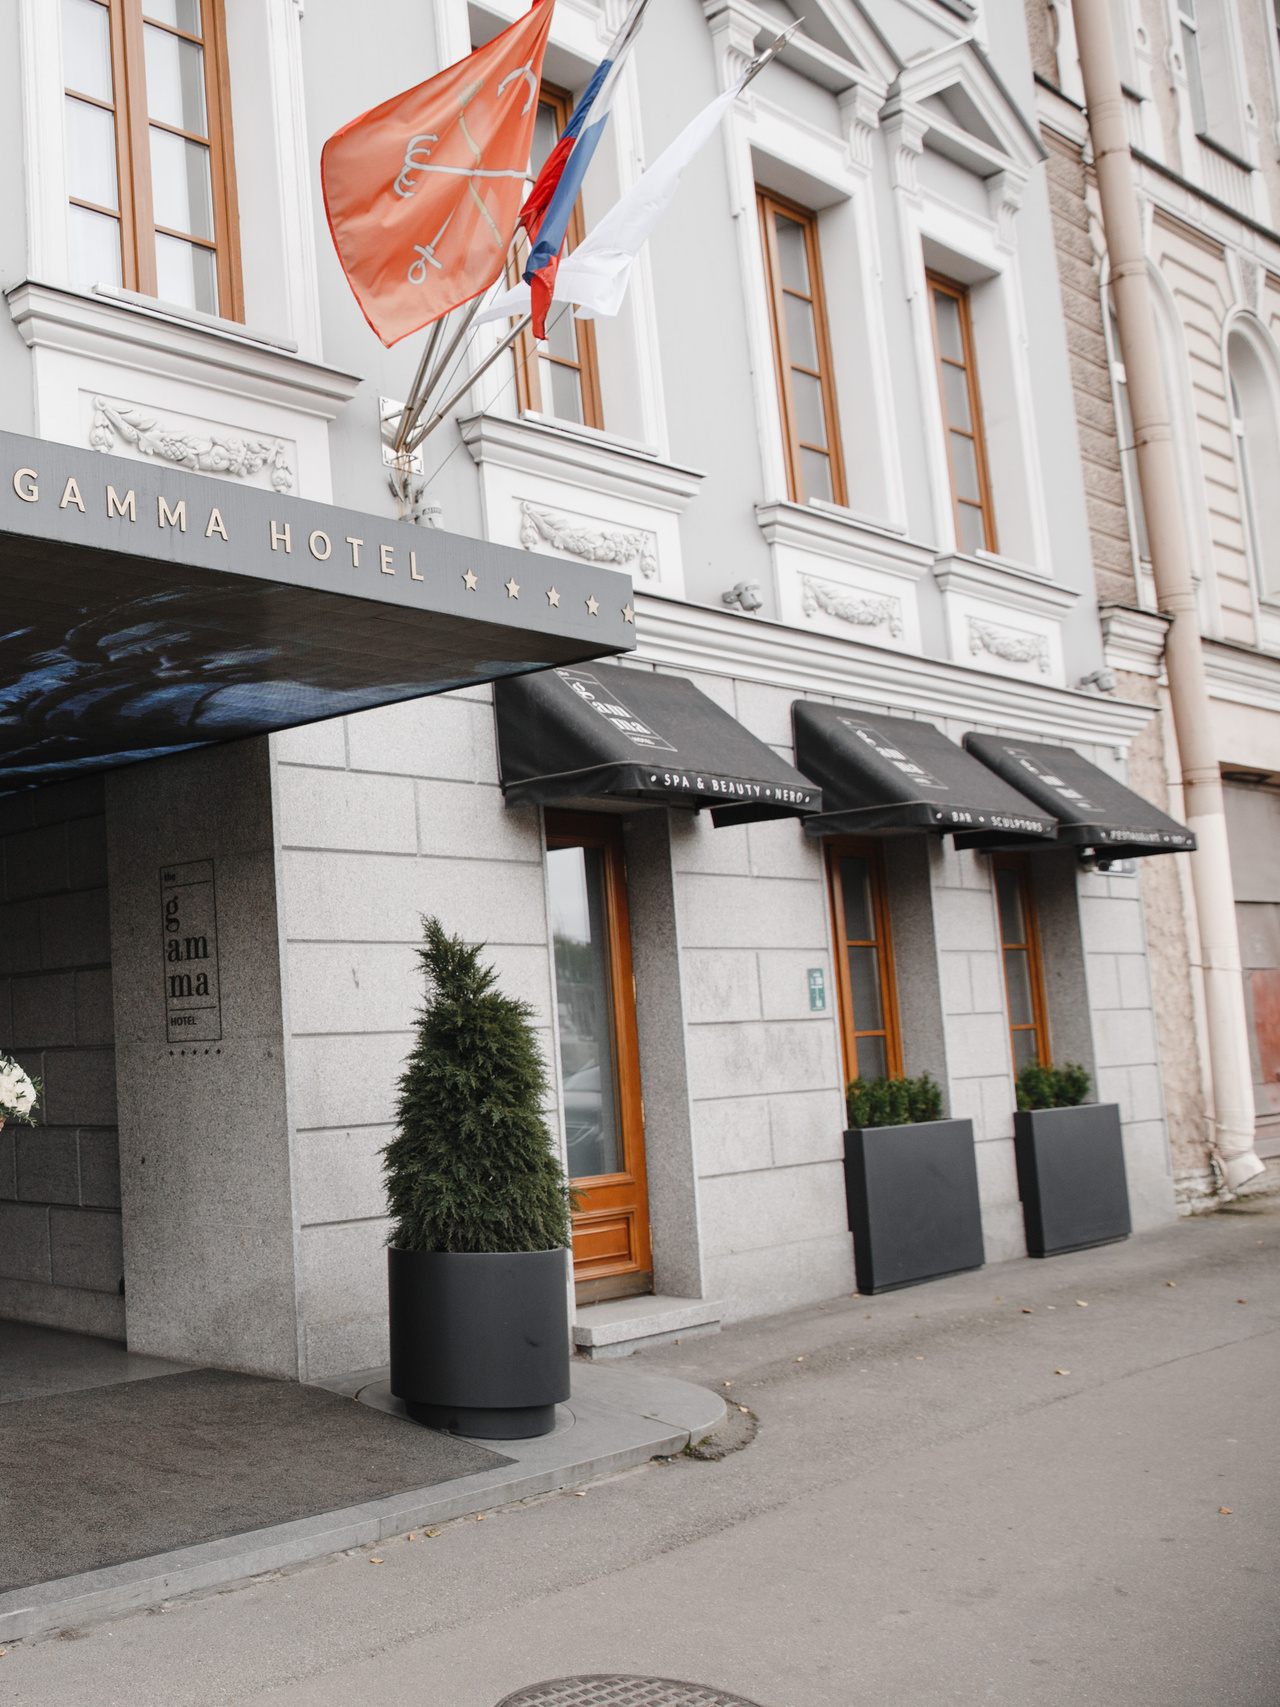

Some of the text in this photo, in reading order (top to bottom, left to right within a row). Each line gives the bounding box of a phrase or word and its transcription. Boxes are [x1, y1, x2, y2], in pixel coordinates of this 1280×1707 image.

[12, 467, 228, 541] GAMMA
[269, 519, 424, 581] HOTEL
[664, 773, 690, 788] SPA
[697, 777, 705, 790] &
[712, 779, 761, 797] BEAUTY
[951, 811, 972, 823] BAR
[165, 895, 180, 933] g
[167, 935, 210, 962] am
[169, 972, 210, 998] ma
[170, 1016, 197, 1027] HOTEL
